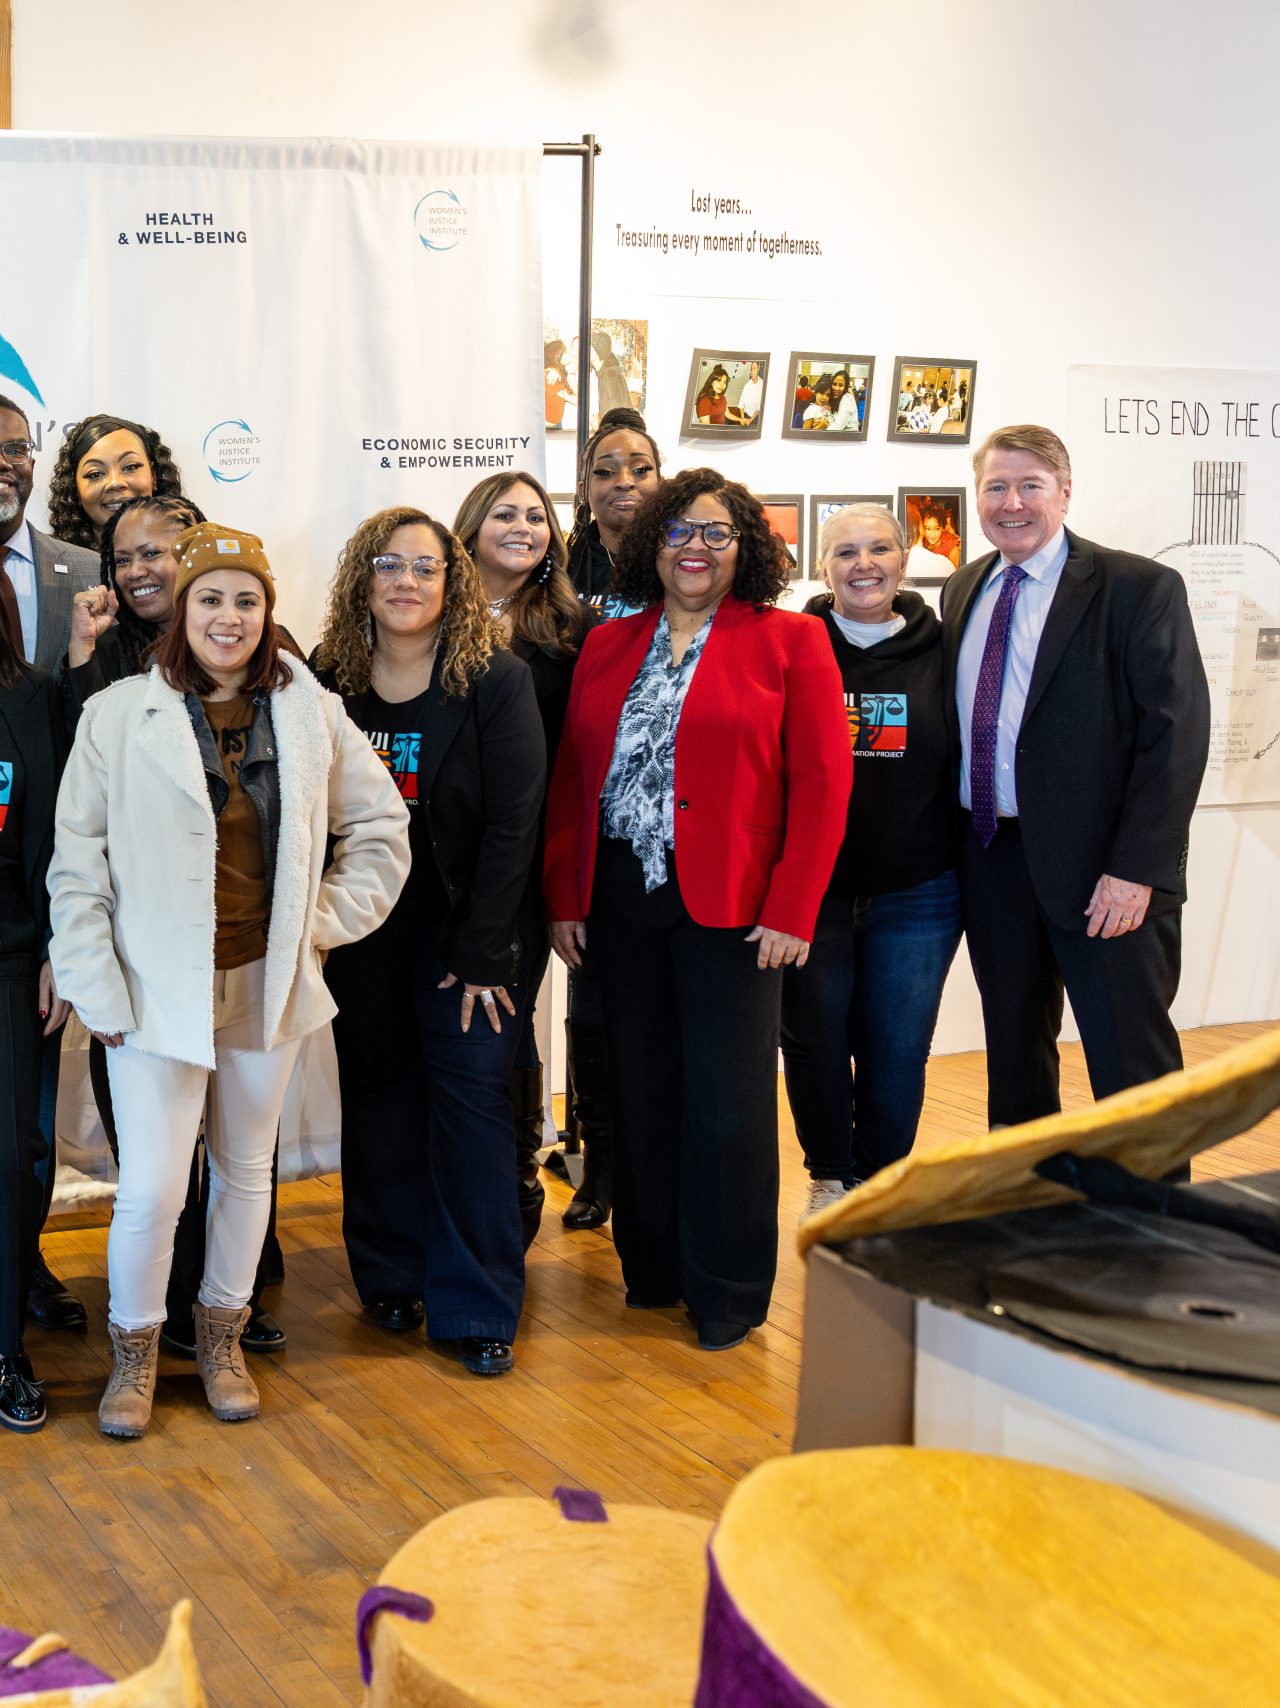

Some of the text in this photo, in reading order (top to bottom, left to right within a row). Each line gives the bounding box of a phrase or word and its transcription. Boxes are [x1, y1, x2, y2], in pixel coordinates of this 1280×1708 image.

[691, 188, 752, 220] Lost years...
[428, 207, 468, 215] WOMEN'S
[145, 213, 214, 226] HEALTH
[428, 217, 458, 225] JUSTICE
[429, 227, 468, 235] INSTITUTE
[117, 231, 247, 245] & WELL-BEING
[616, 223, 823, 259] Treasuring every moment of togetherness.
[1104, 398, 1160, 435] LETS
[1171, 401, 1210, 436] END
[1222, 402, 1260, 437] THE
[218, 436, 261, 445] WOMEN'S
[362, 436, 531, 451] ECONOMIC SECURITY
[218, 447, 251, 456] JUSTICE
[219, 457, 261, 466] INSTITUTE
[380, 455, 514, 469] & EMPOWERMENT
